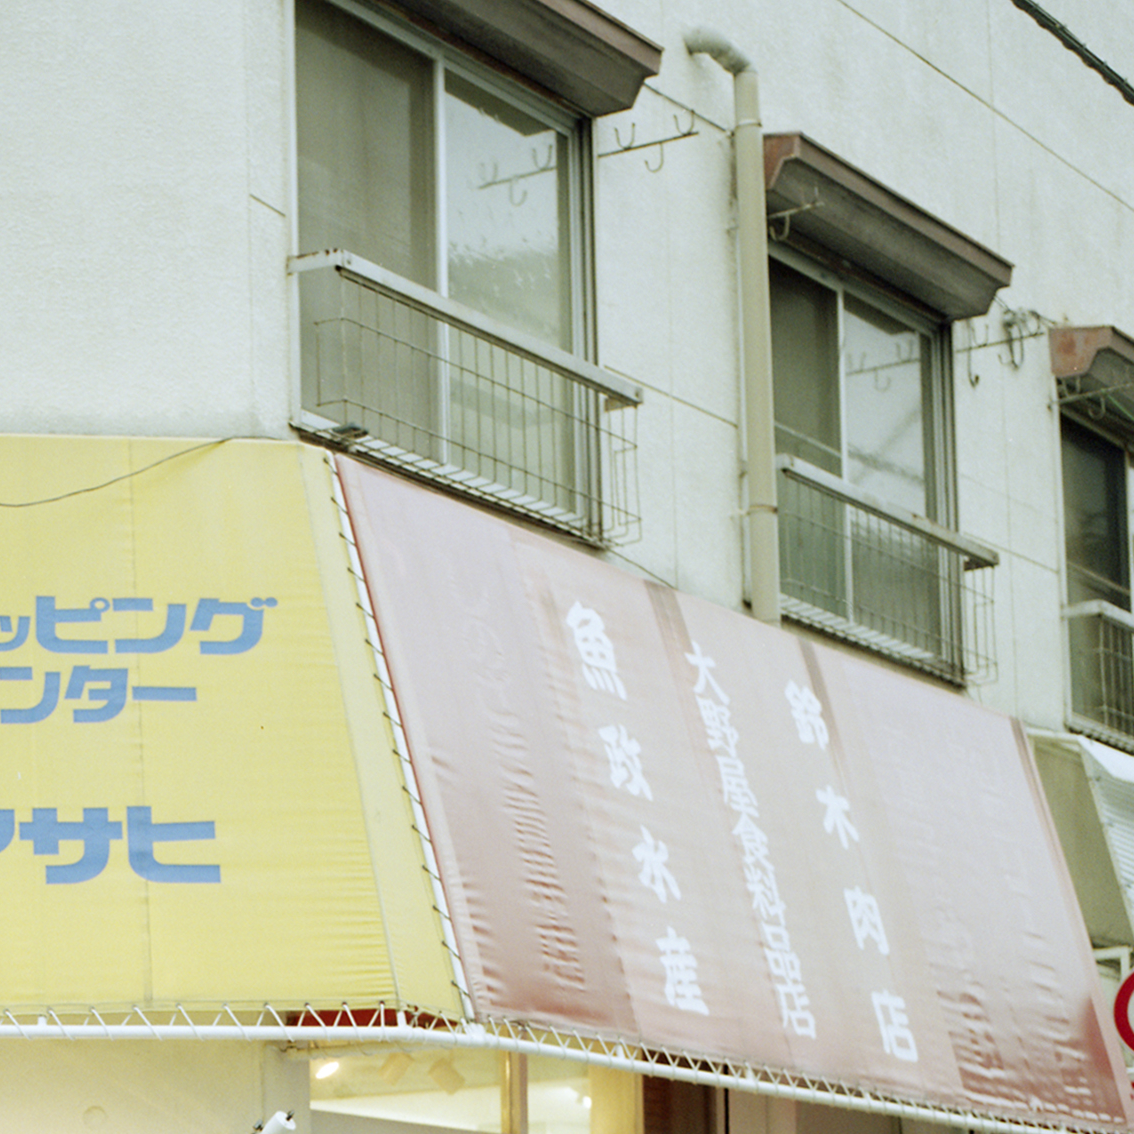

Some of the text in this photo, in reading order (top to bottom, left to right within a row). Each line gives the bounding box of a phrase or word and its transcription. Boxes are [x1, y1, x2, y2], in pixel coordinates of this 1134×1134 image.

[686, 639, 817, 1040] 大野屋食料品店
[784, 679, 918, 1064] 鈴木肉店
